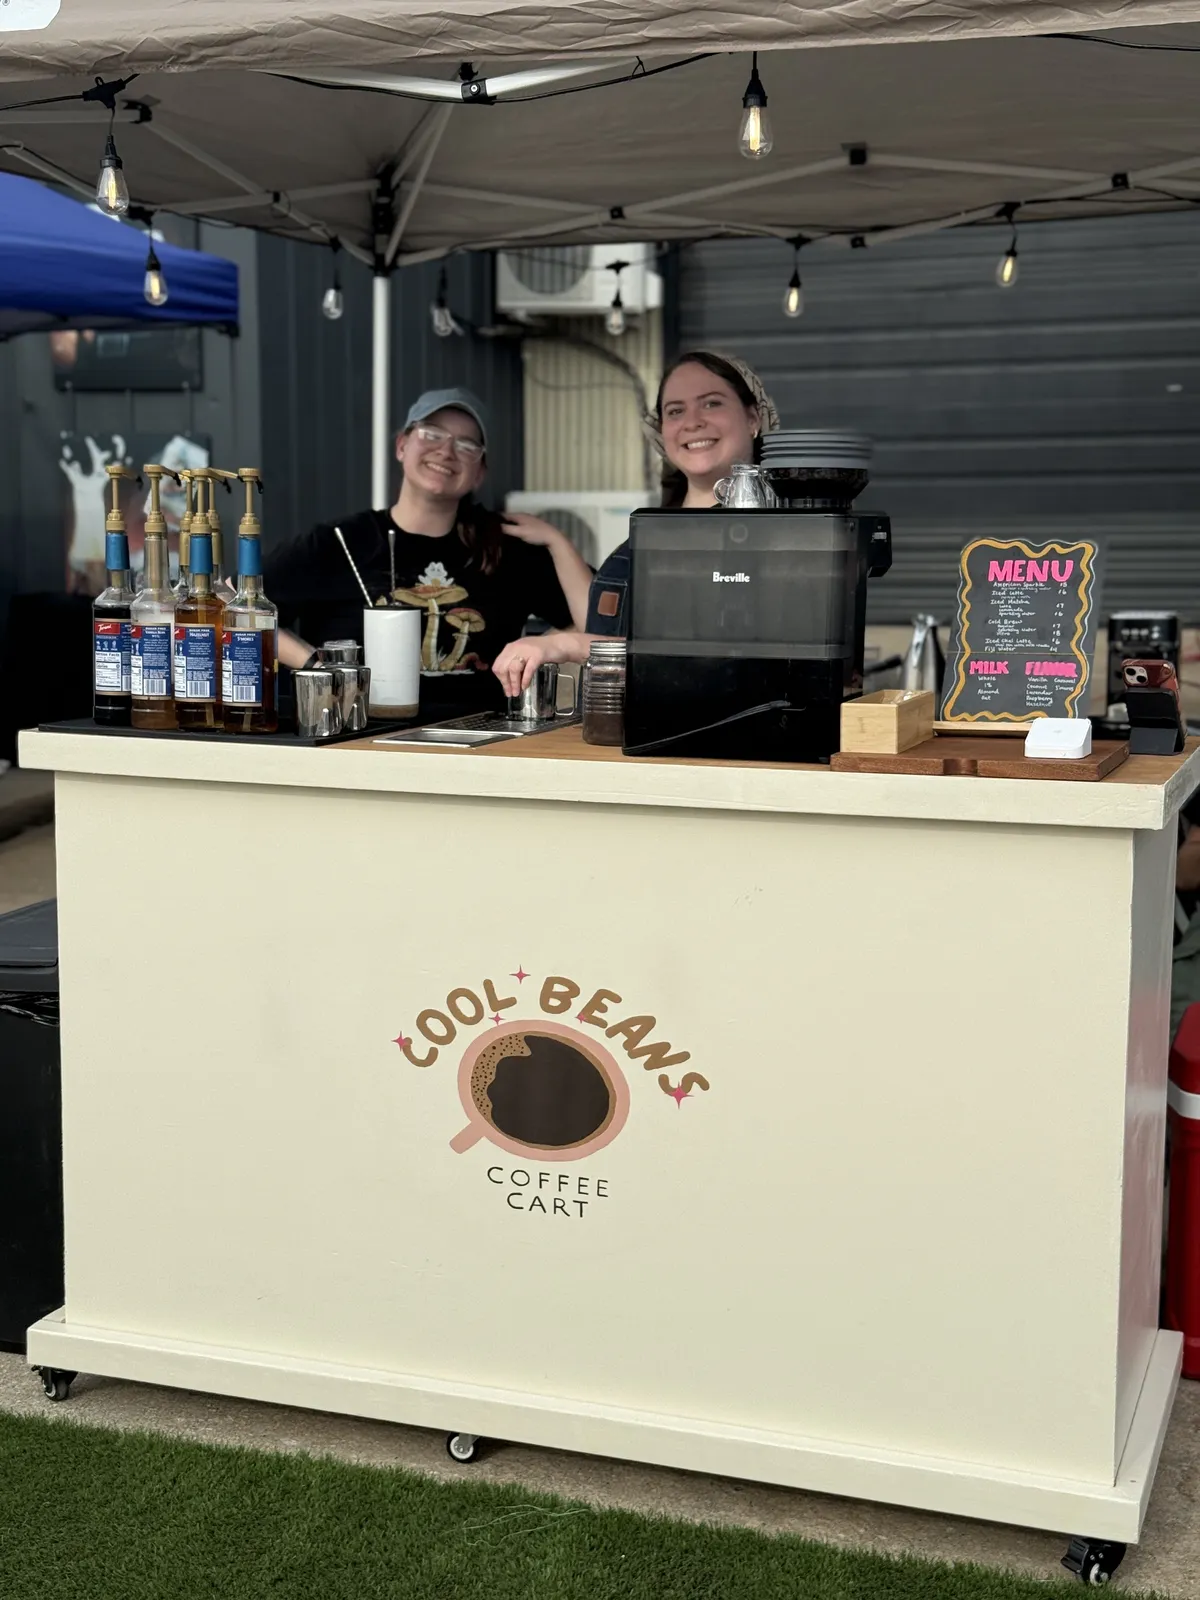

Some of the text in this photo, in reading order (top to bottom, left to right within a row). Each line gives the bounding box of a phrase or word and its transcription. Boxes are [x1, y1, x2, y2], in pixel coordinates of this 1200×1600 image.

[713, 571, 750, 582] Breville
[988, 560, 1074, 582] MENU
[969, 660, 1009, 675] MILK
[402, 976, 710, 1096] COOL BEANS
[487, 1166, 608, 1198] COFFEE
[506, 1192, 588, 1218] CART
